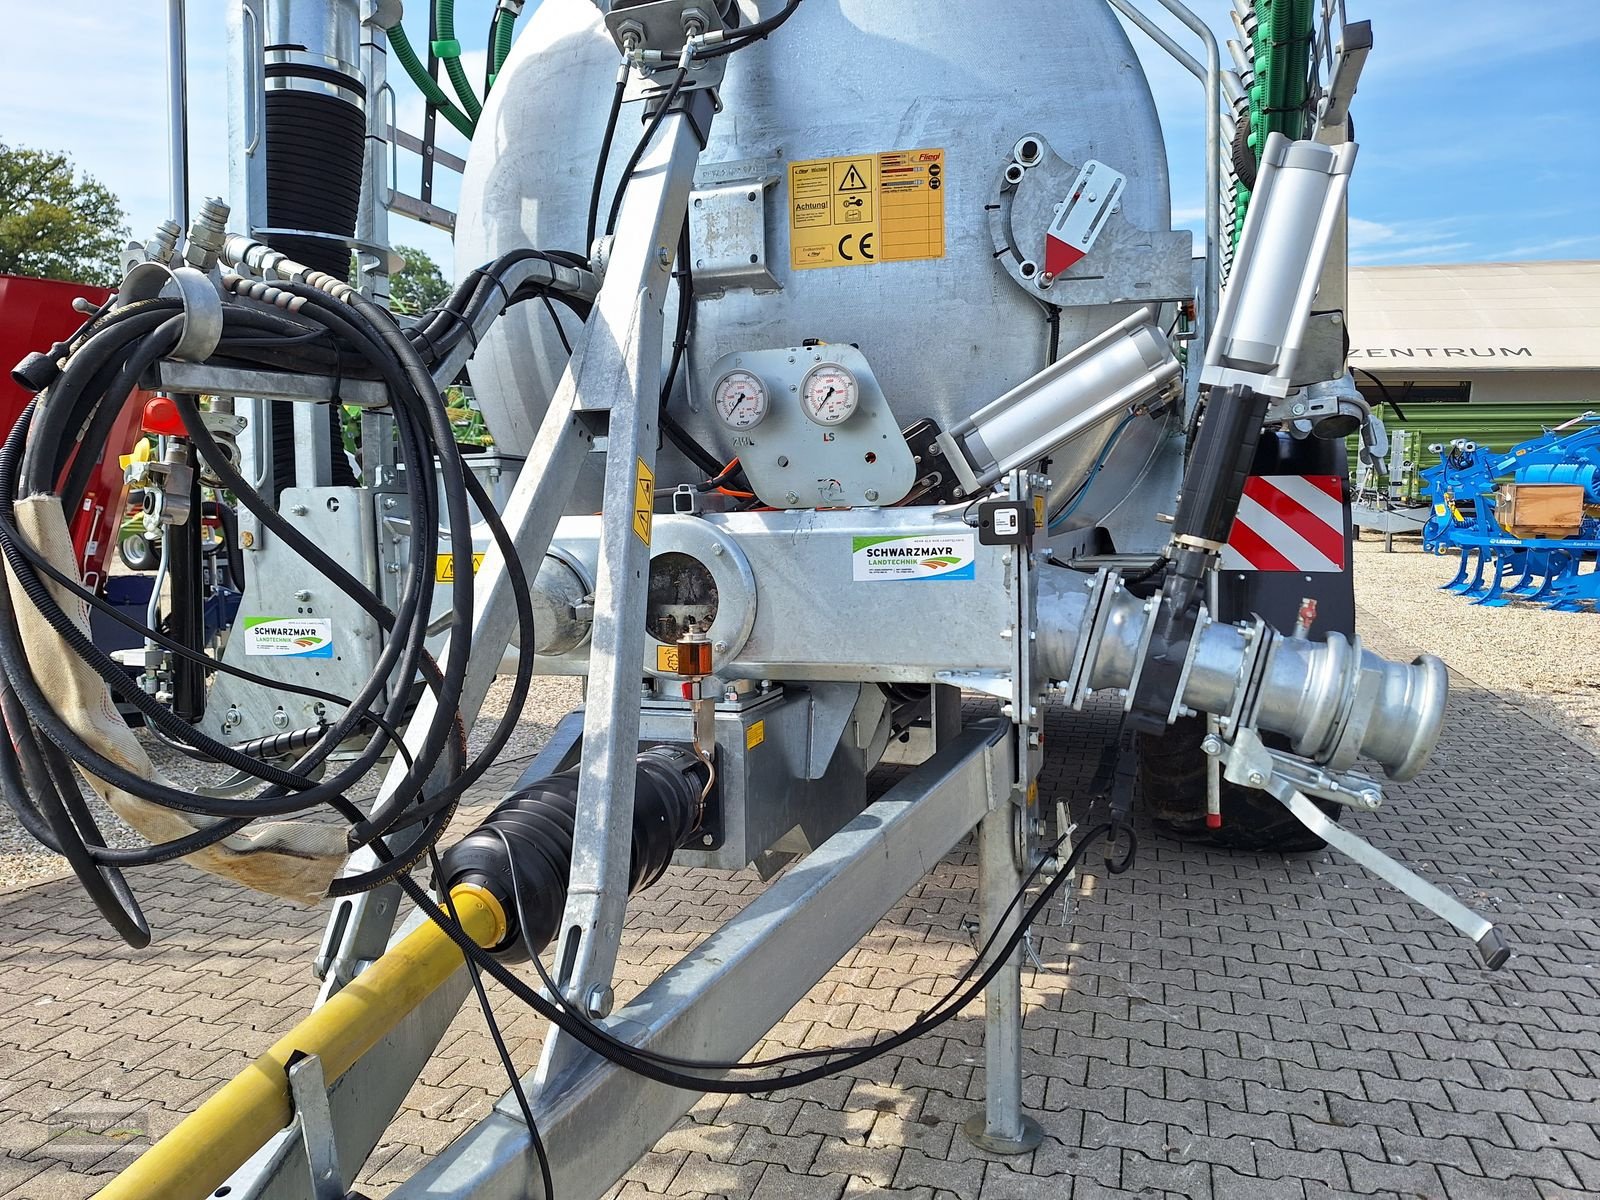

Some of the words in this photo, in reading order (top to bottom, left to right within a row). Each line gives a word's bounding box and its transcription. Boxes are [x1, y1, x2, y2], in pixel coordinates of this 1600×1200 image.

[919, 152, 941, 161] Fliegl
[795, 201, 828, 211] Achtung!
[1346, 347, 1533, 358] ZENTRUM
[823, 432, 835, 442] LS
[866, 546, 953, 557] SCHWARZMAYR
[868, 558, 918, 566] LANDTECHNIK
[254, 627, 317, 636] SCHWARZMAYR
